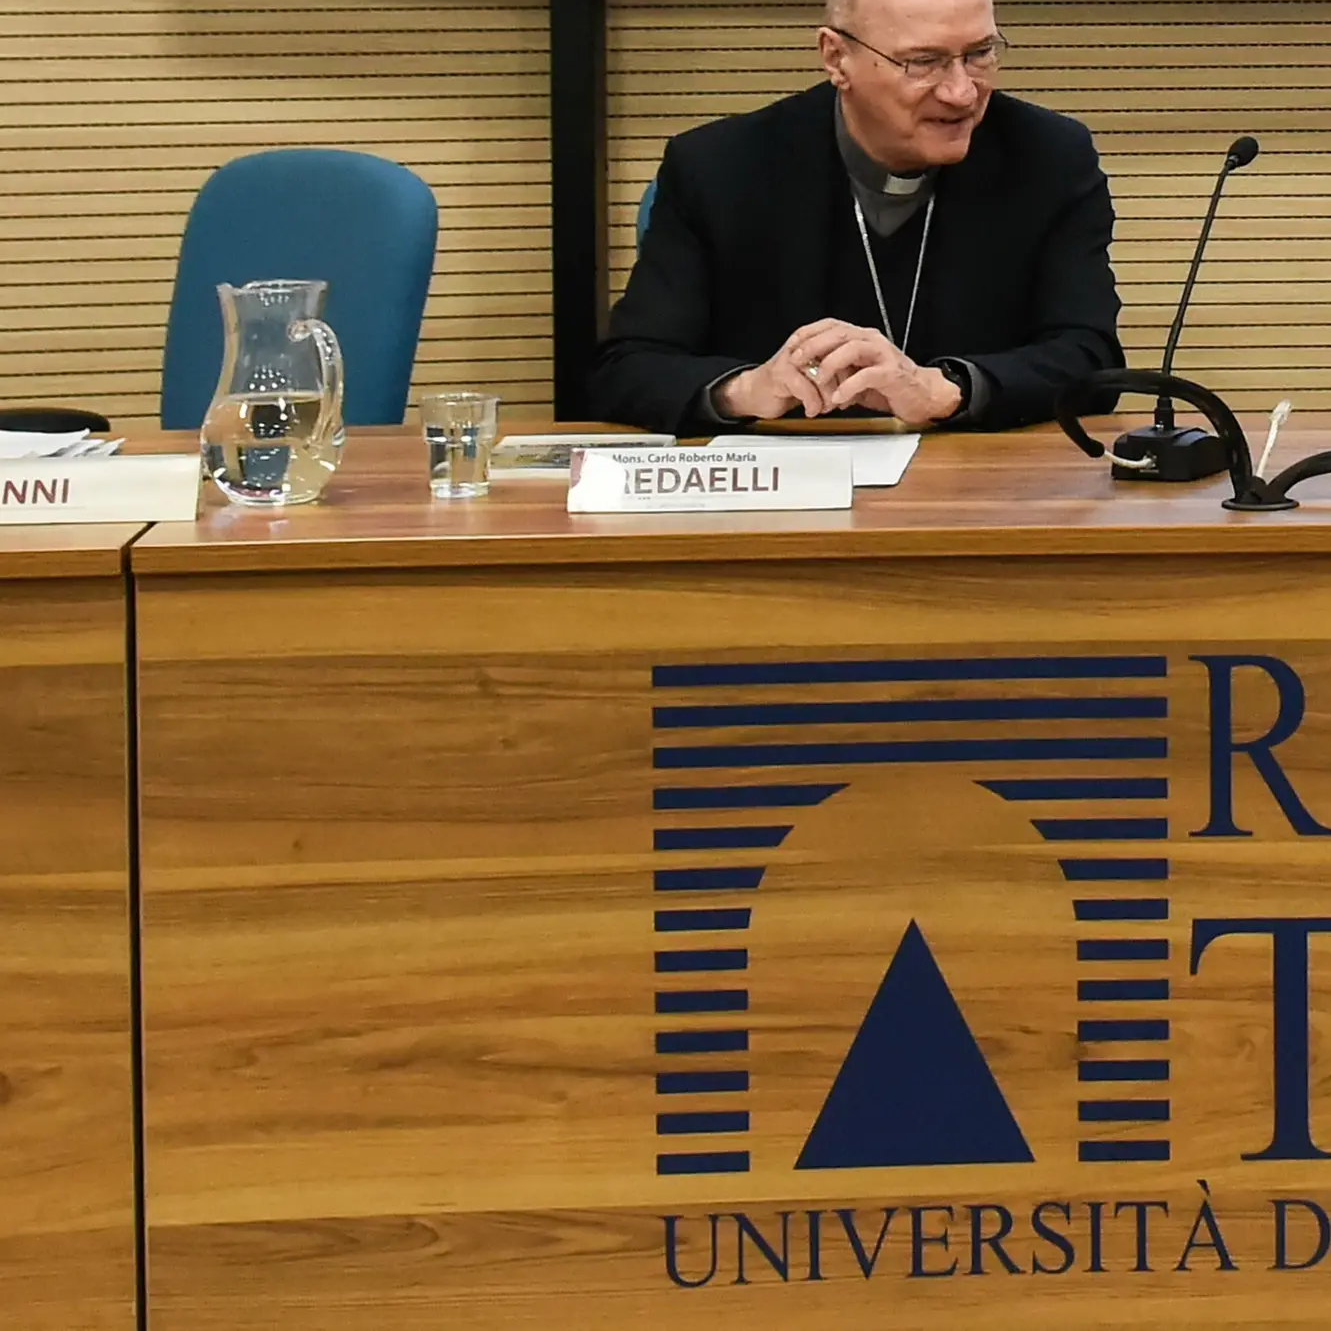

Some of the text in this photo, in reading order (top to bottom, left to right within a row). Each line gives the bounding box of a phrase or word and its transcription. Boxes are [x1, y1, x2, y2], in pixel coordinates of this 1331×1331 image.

[612, 452, 757, 464] Mons. Carlo Roberto Maria
[661, 1179, 1241, 1288] UNIVERSITÀ
